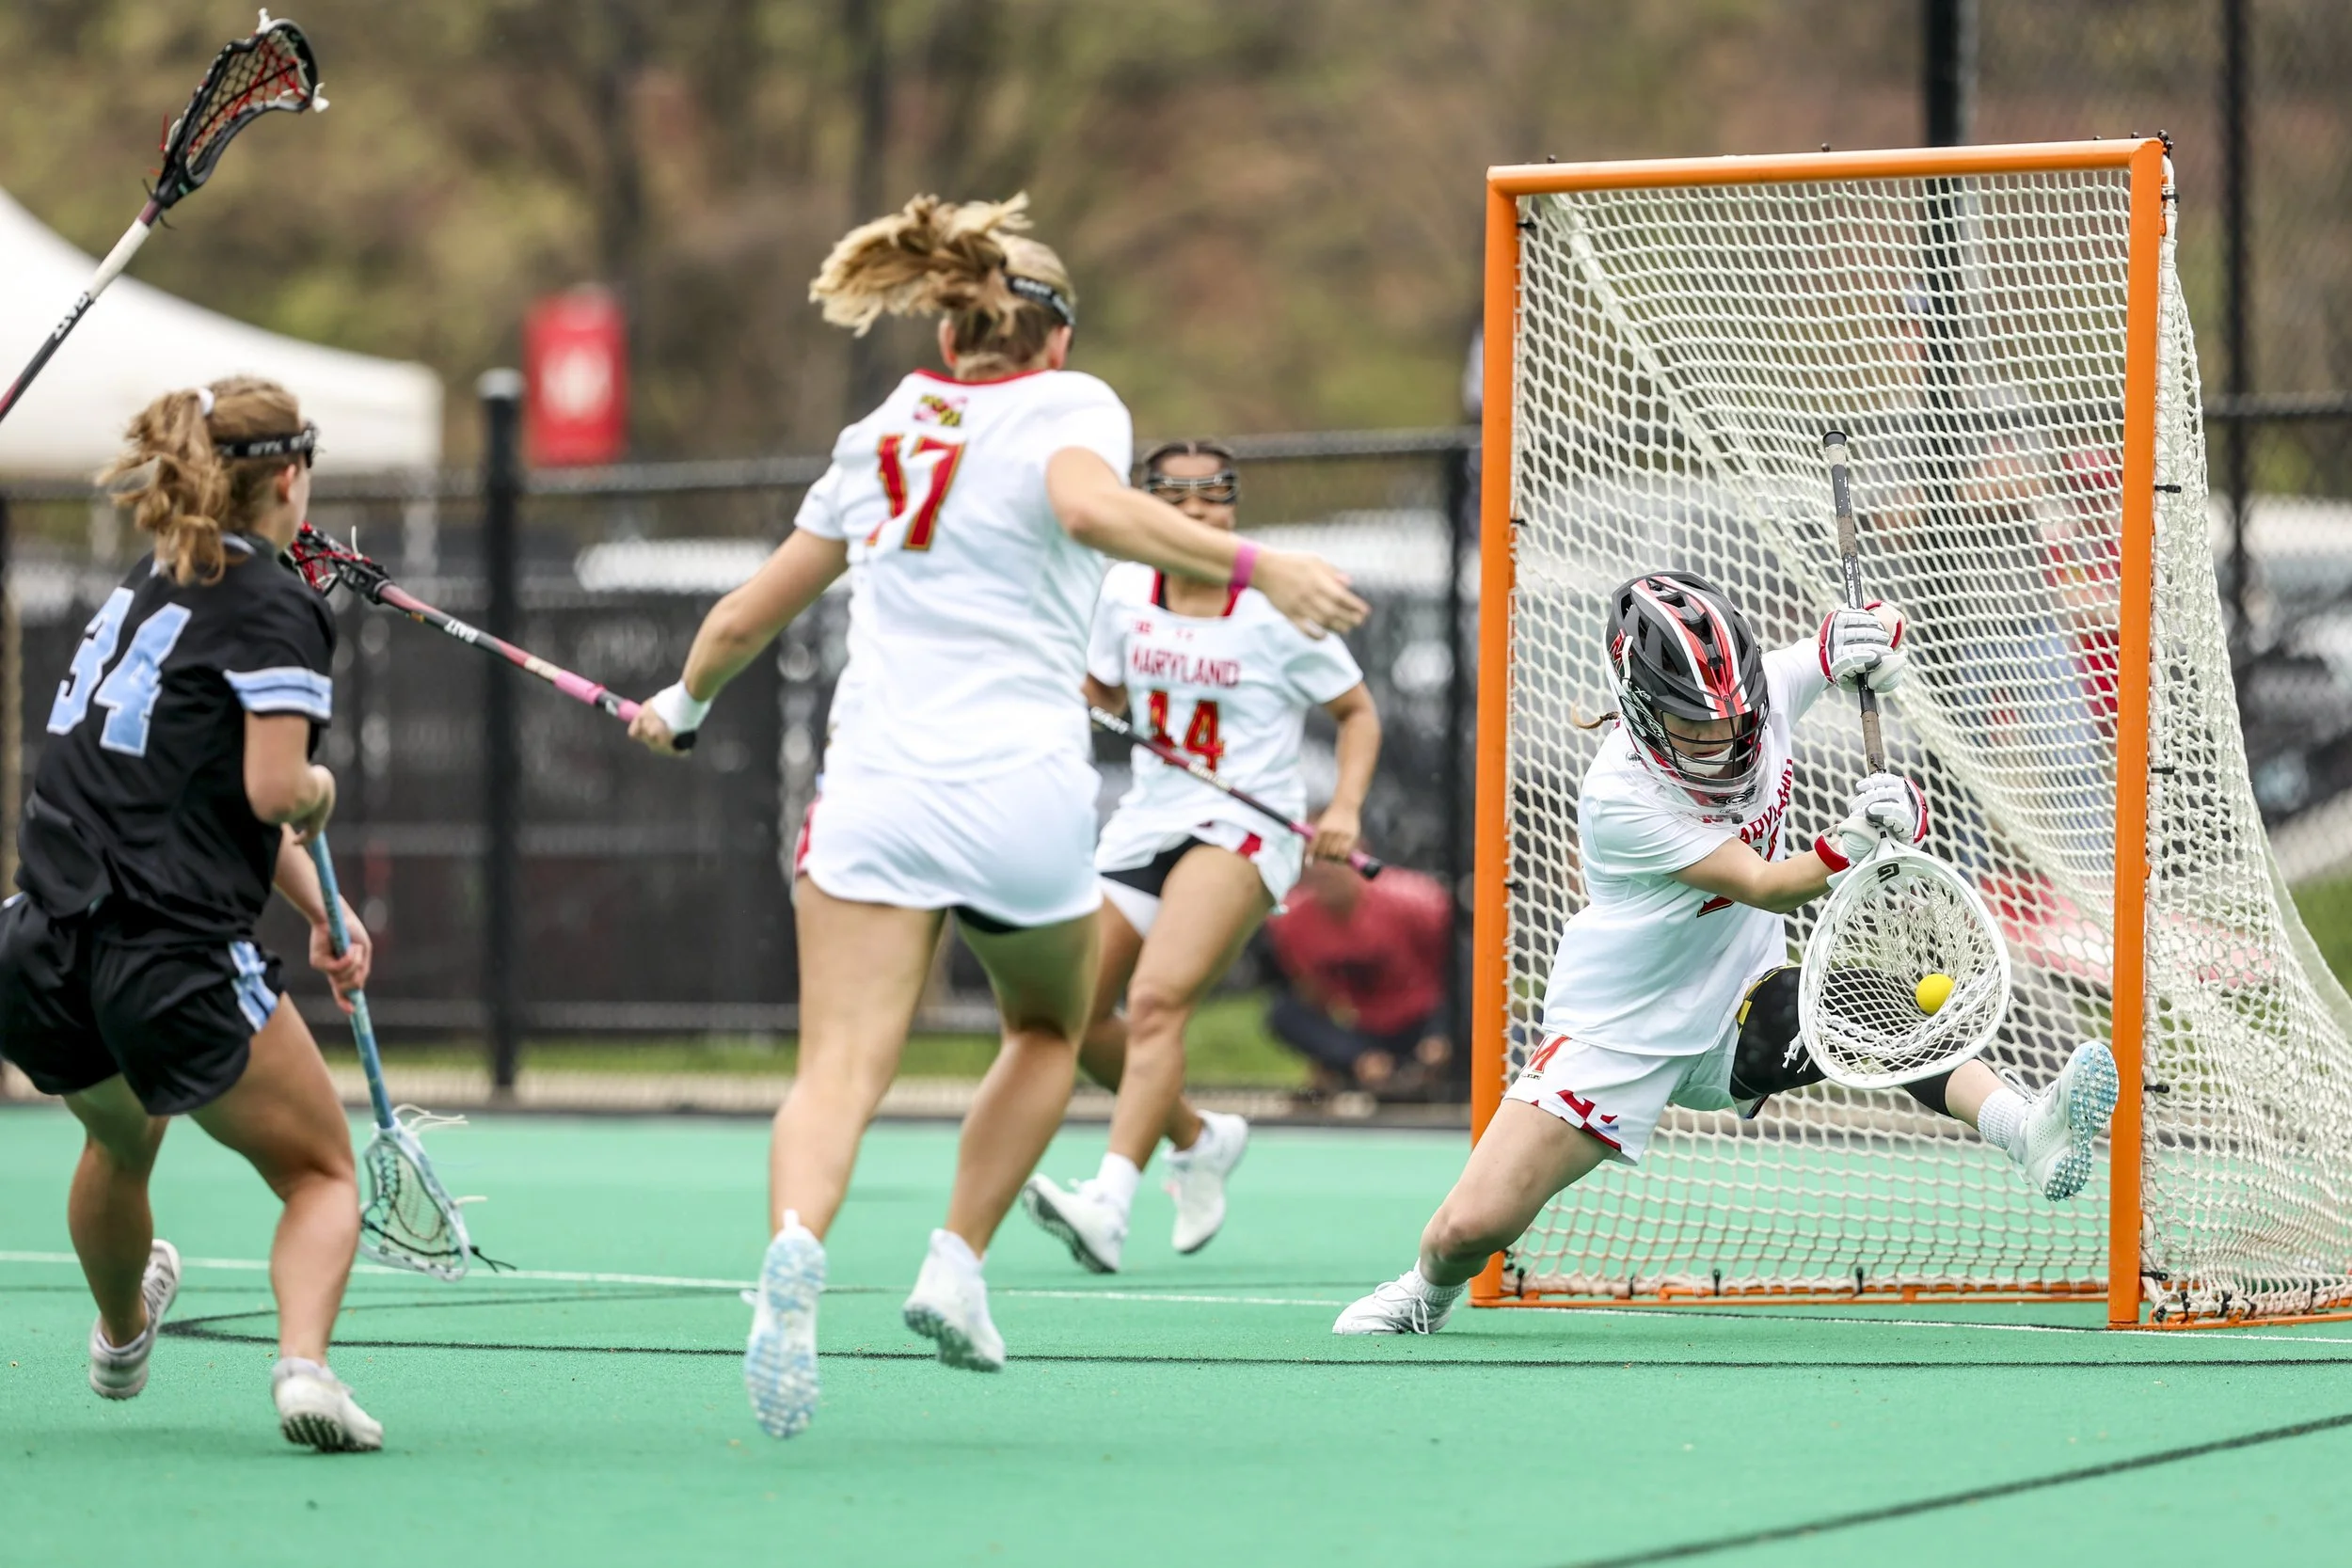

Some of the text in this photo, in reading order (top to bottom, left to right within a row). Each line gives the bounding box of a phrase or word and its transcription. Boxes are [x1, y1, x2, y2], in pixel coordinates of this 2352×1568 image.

[865, 433, 967, 551] 17
[46, 587, 191, 758] 34
[1149, 689, 1225, 772] 14
[1740, 758, 1792, 845] ARYLAND
